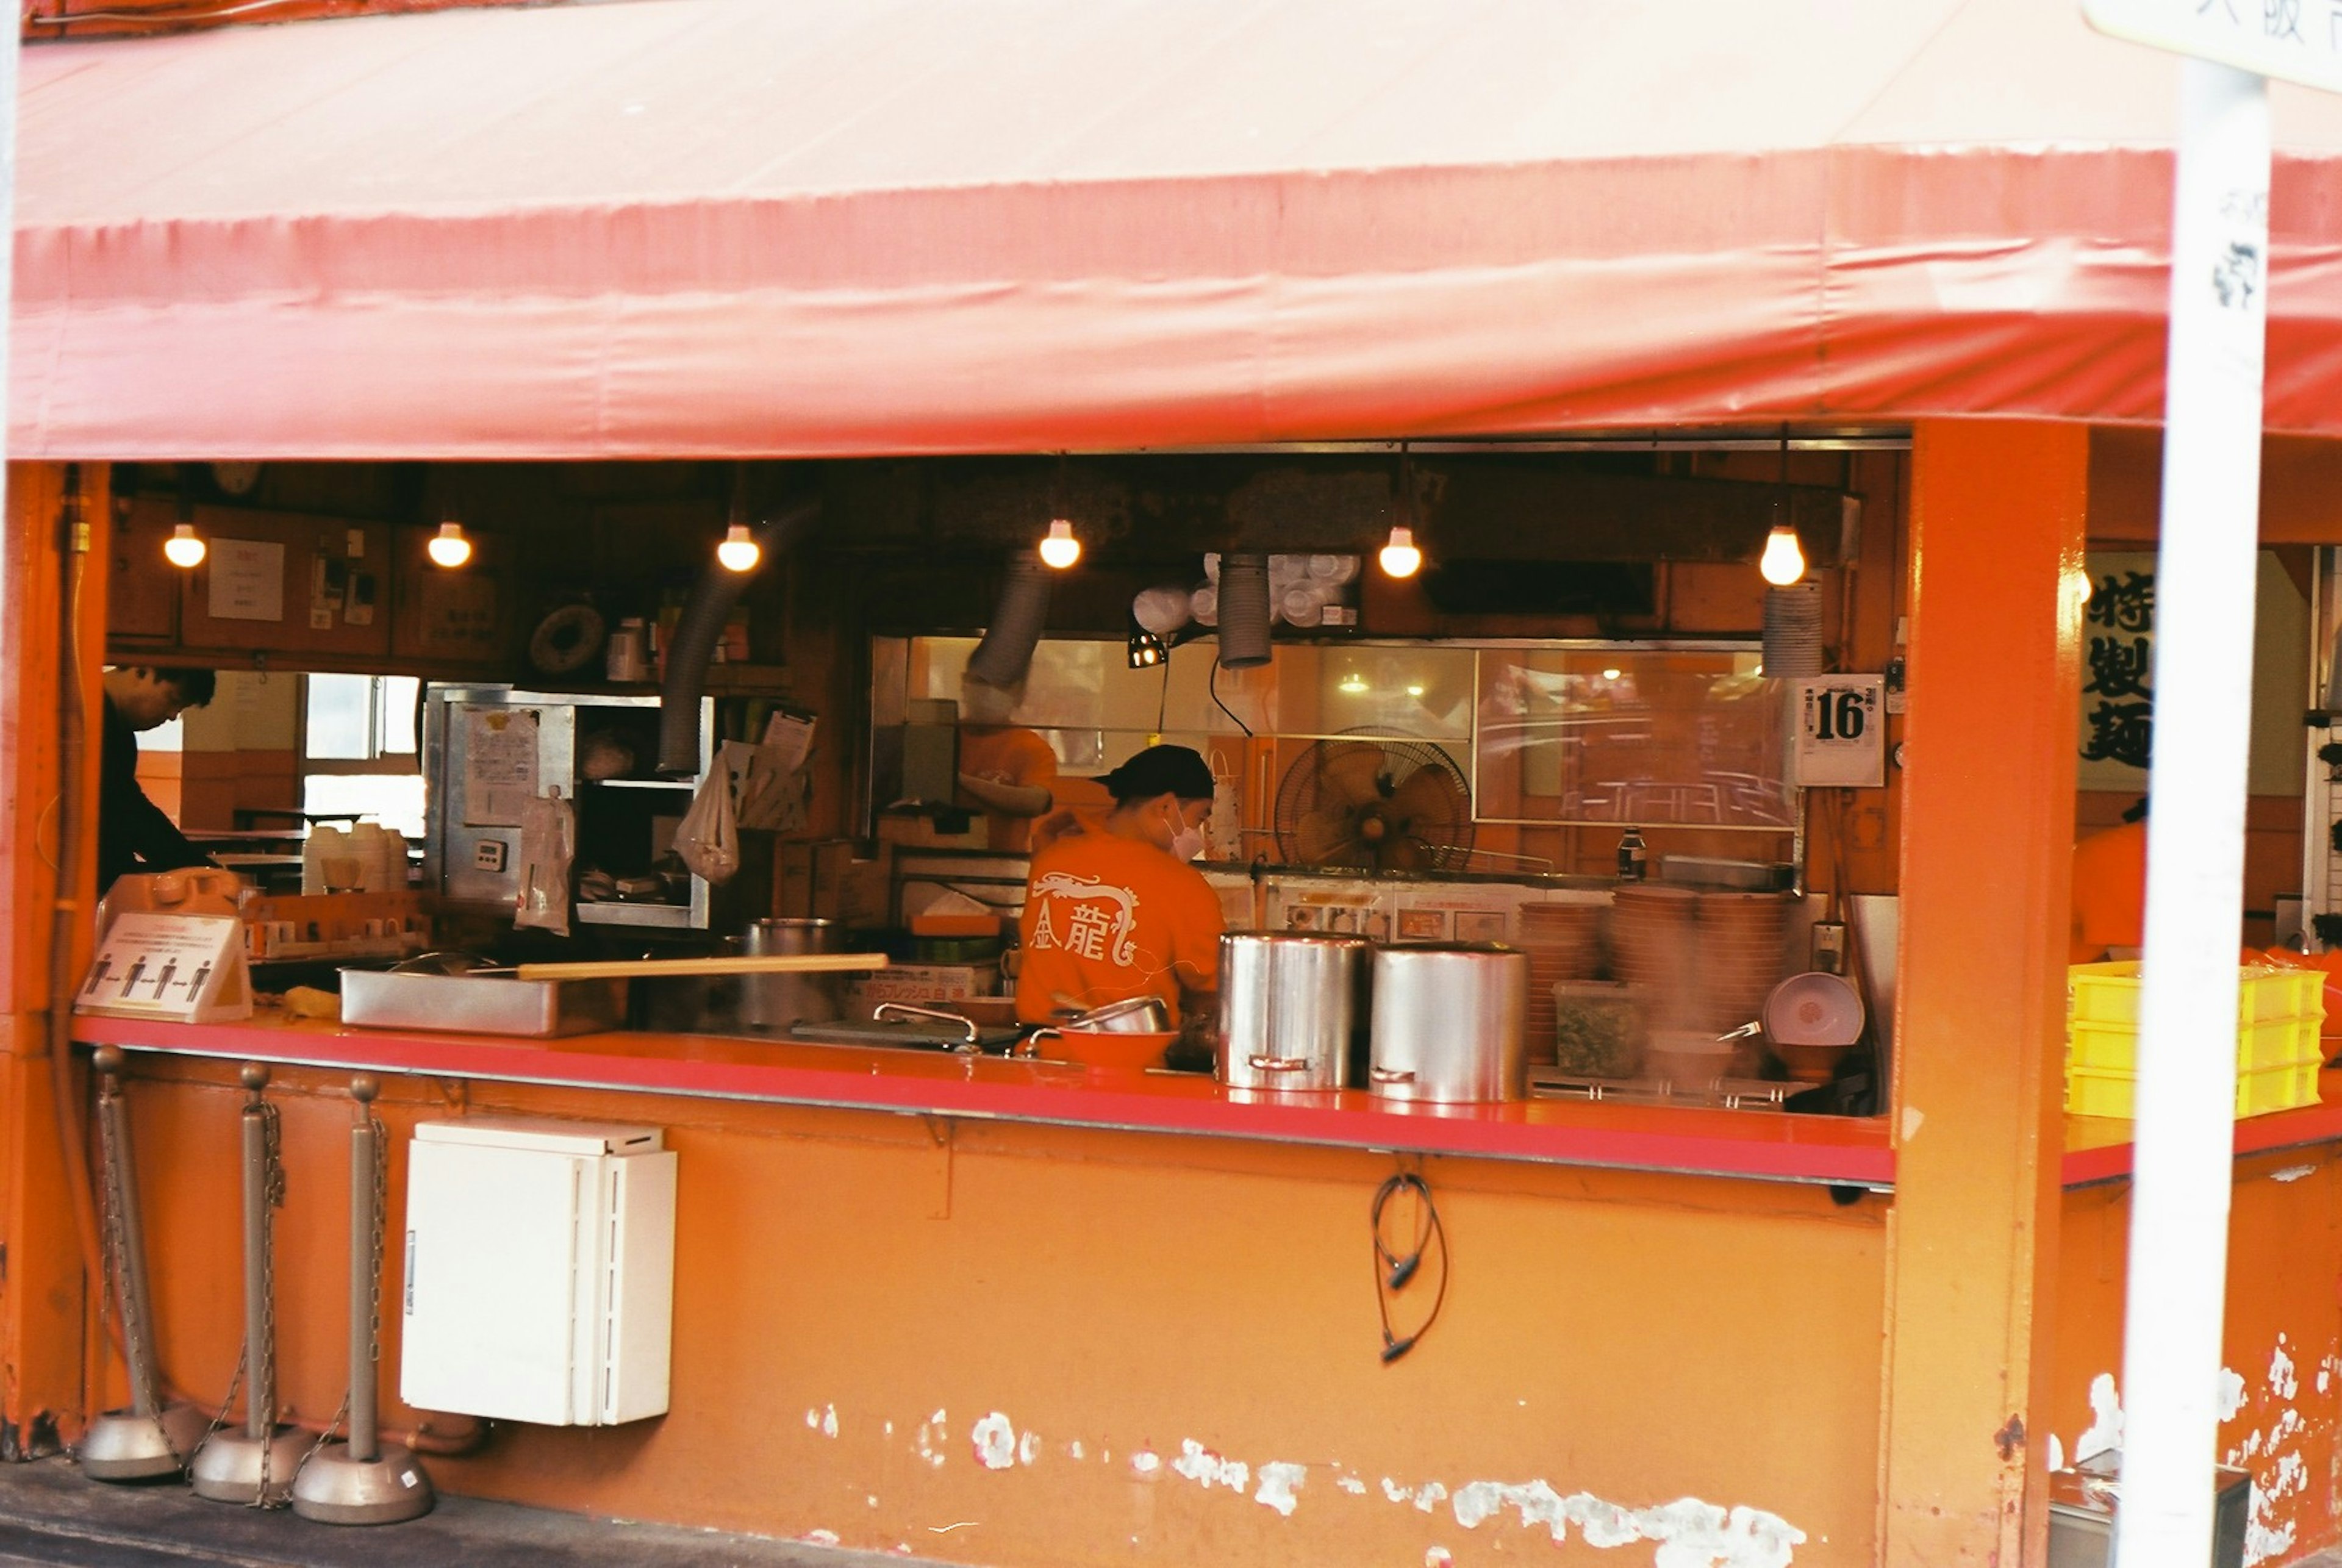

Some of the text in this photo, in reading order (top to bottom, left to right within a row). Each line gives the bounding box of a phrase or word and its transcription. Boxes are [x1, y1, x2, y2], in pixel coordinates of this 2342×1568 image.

[2196, 0, 2342, 52] 大阪
[1816, 692, 1864, 739] 16
[1030, 898, 1111, 961] 金龍
